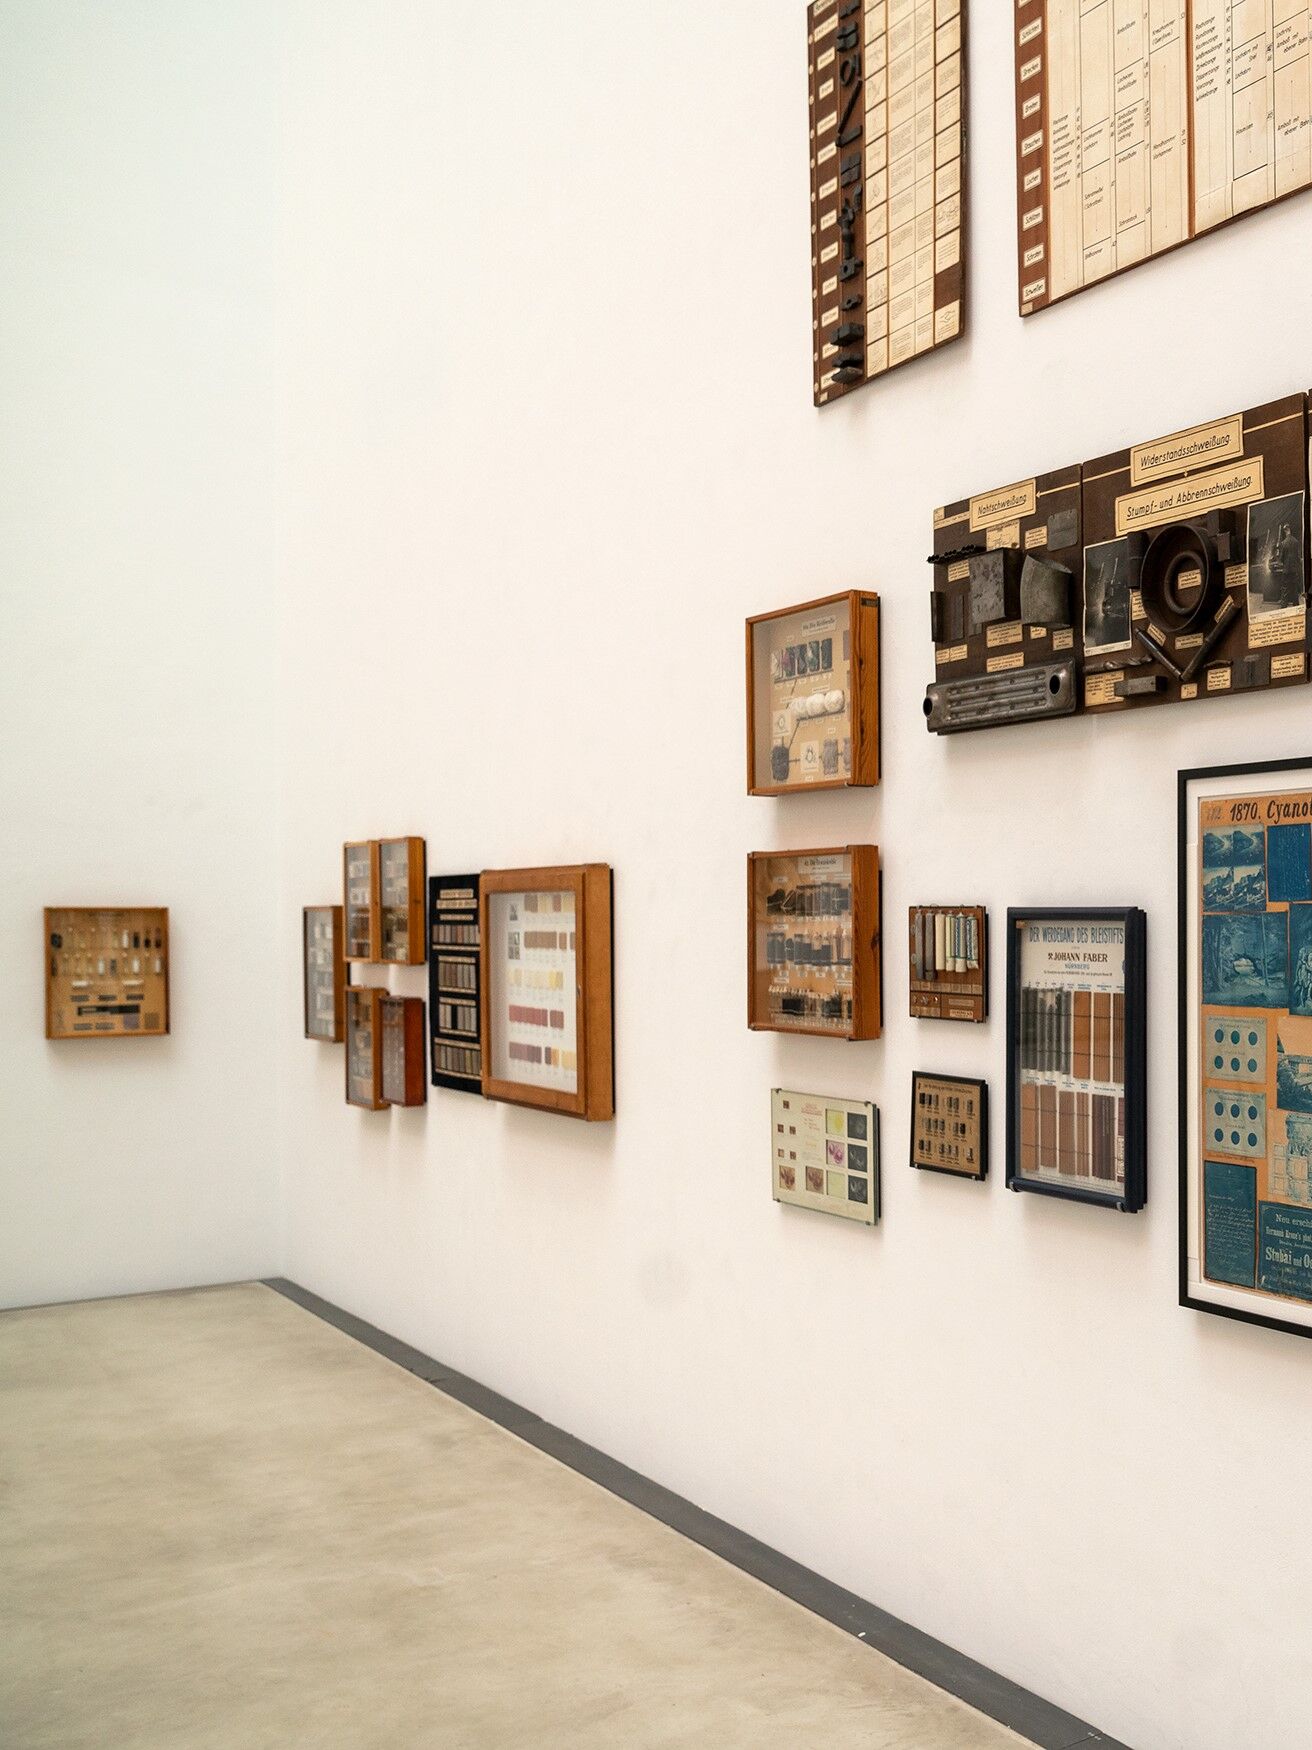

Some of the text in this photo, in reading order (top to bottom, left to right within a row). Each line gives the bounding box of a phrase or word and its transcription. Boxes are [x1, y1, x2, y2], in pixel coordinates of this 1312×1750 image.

[1127, 501, 1158, 518] Stumpf-
[1159, 494, 1173, 508] und
[1230, 802, 1261, 823] 1870.
[1029, 927, 1124, 944] DER WERDEGANG DES BLEISTIFTS
[1054, 952, 1108, 963] JOHANN FABER
[1275, 1213, 1290, 1224] Neu
[1265, 1247, 1292, 1265] Stubai
